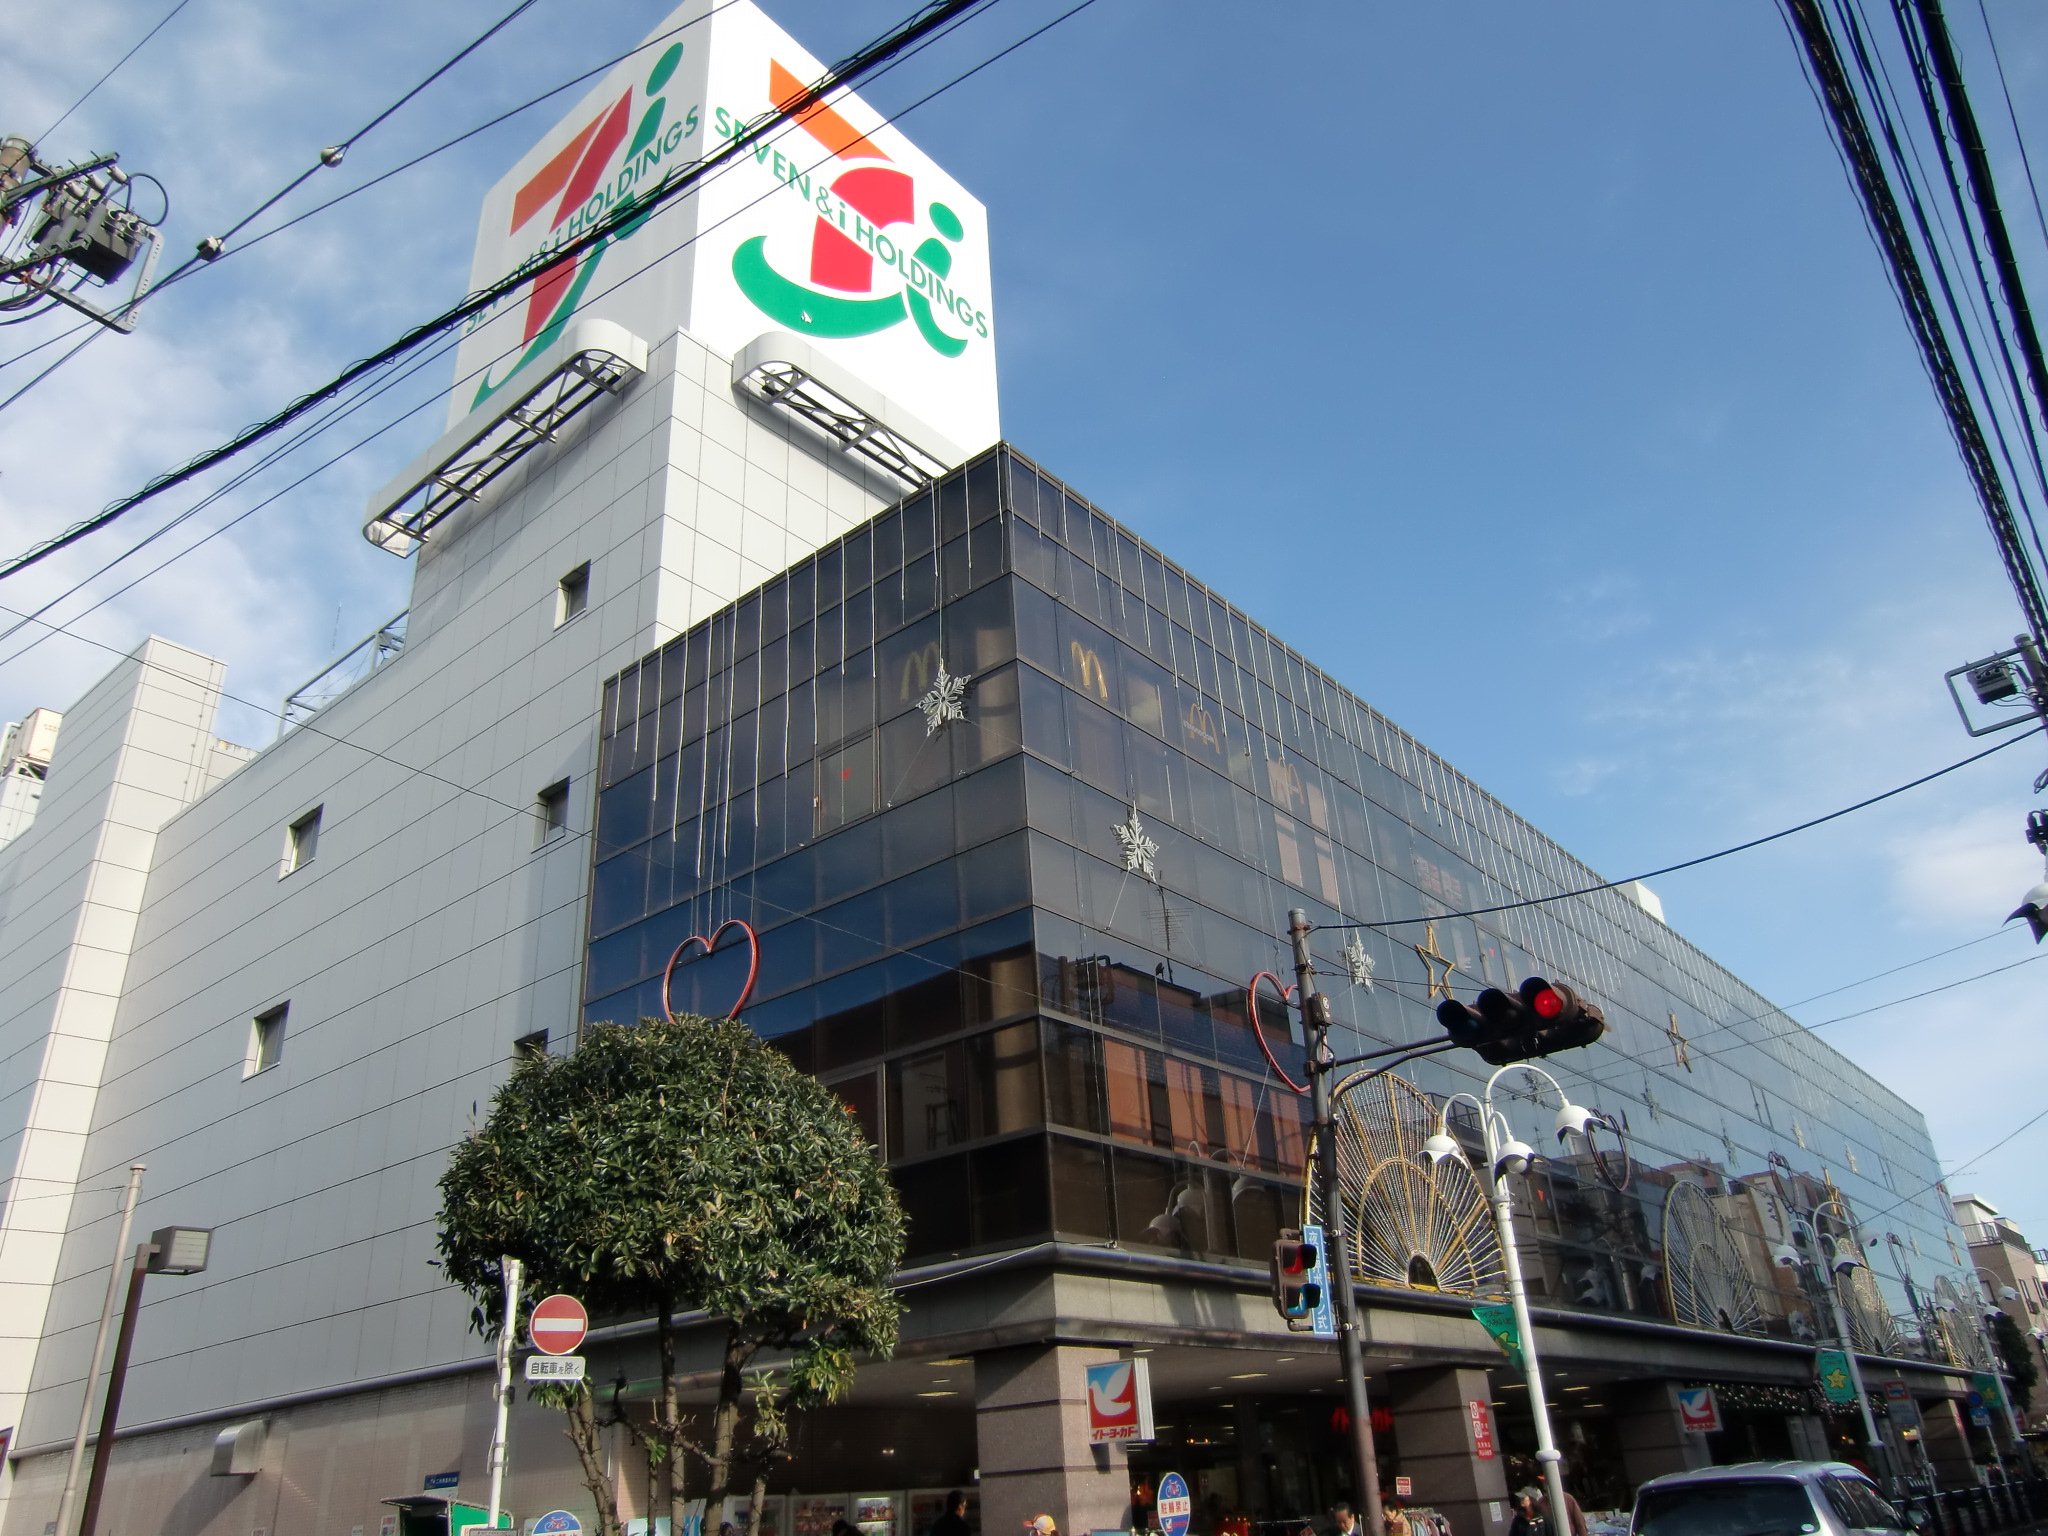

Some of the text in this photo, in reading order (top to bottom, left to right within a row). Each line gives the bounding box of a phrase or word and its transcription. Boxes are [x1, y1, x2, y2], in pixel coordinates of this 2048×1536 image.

[567, 104, 699, 241] HOLDINGS
[856, 214, 988, 339] HOLDINGS
[531, 1361, 580, 1375] 自転車を除く
[1092, 1426, 1138, 1440] イトーヨーカドー
[1160, 1500, 1188, 1514] 駐輪禁止
